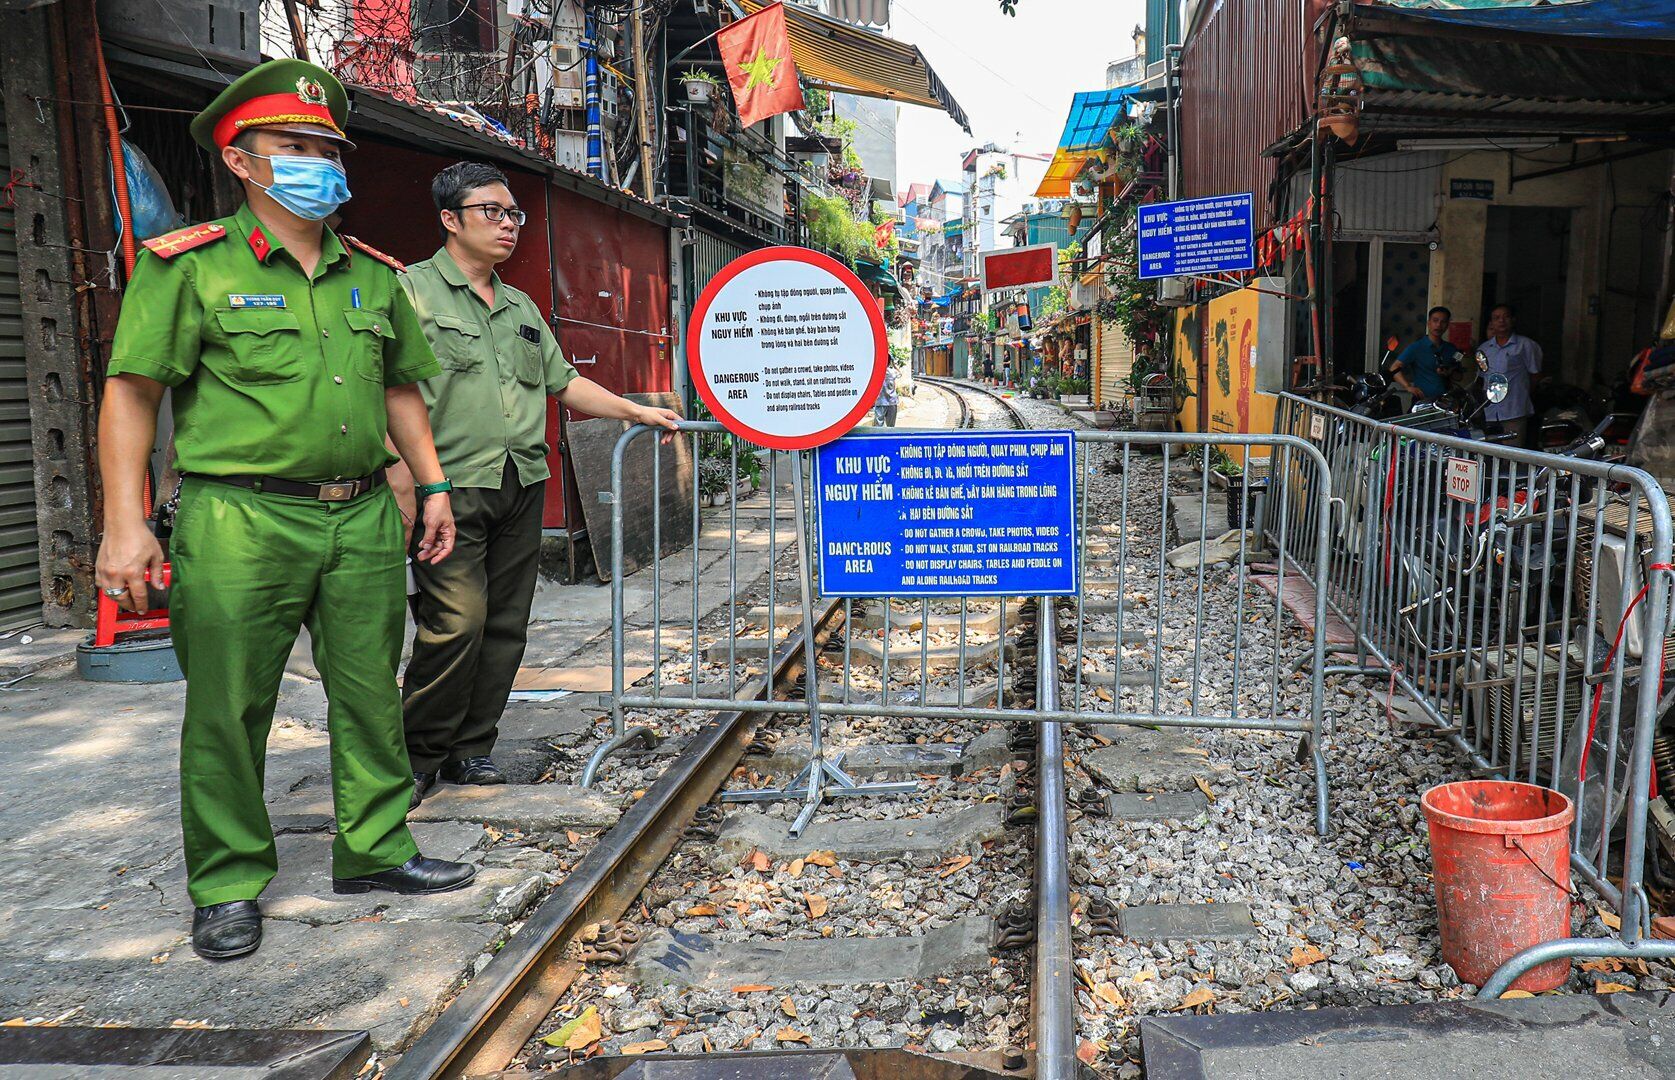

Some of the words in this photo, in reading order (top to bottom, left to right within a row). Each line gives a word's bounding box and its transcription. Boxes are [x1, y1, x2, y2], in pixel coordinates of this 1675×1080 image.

[1143, 214, 1155, 224] KHU
[1141, 228, 1156, 238] NGUY
[1142, 251, 1171, 261] DANGEROUS
[1149, 262, 1163, 270] AREA
[758, 290, 774, 298] Không
[820, 287, 832, 296] quay
[758, 302, 771, 312] chụp
[715, 312, 730, 322] KHU
[732, 311, 747, 324] VỰC
[760, 315, 775, 323] Không
[811, 312, 821, 321] trên
[838, 310, 846, 320] sắt
[712, 328, 731, 339] NGUY
[733, 324, 753, 339] HIỂM
[761, 327, 776, 336] Không
[761, 340, 774, 349] trong
[804, 338, 813, 347] bên
[830, 336, 838, 345] sắt
[764, 367, 771, 375] Do
[779, 366, 793, 375] gather
[798, 365, 812, 373] crowd,
[813, 364, 822, 373] take
[823, 364, 839, 372] photos,
[714, 372, 759, 384] DANGEROUS
[765, 379, 772, 387] Do
[780, 379, 792, 387] walk,
[793, 378, 806, 386] stand,
[820, 376, 837, 385] railroad
[837, 376, 851, 384] tracks
[728, 389, 748, 399] AREA
[781, 390, 796, 399] display
[827, 389, 836, 397] and
[836, 388, 851, 397] peddle
[766, 404, 775, 412] and
[776, 403, 788, 412] along
[789, 403, 806, 411] railroad
[806, 402, 820, 410] tracks
[900, 443, 923, 458] KHÔNG
[924, 446, 932, 460] TỤ
[933, 443, 946, 460] TẬP
[947, 443, 966, 457] ĐÔNG
[967, 441, 989, 458] NGƯỜI,
[991, 445, 1008, 458] QUAY
[1010, 444, 1029, 457] PHIM,
[1030, 443, 1048, 459] CHỤP
[1050, 439, 1064, 456] ẢNH
[836, 457, 862, 474] KHU
[865, 455, 891, 477] VỰC
[901, 464, 923, 479] KHÔNG
[935, 466, 955, 479] ĐG,
[956, 463, 972, 478] NGỒI
[974, 463, 990, 478] TRÊN
[992, 462, 1014, 477] ĐƯỜNG
[1016, 461, 1029, 477] SẮT
[1456, 463, 1469, 473] POLICE
[825, 484, 858, 501] NGUY
[862, 477, 893, 501] HIỂM
[1452, 476, 1470, 492] STOP
[902, 485, 924, 499] KHÔNG
[935, 484, 949, 499] BÀN
[951, 483, 965, 500] GHẾ,
[982, 484, 995, 498] BÁN
[997, 483, 1014, 498] HÀNG
[1016, 486, 1038, 498] TRONG
[1040, 483, 1057, 497] LÒNG
[910, 508, 921, 520] HAI
[922, 505, 936, 520] BÊN
[937, 505, 959, 520] ĐƯỜNG
[961, 503, 974, 519] SẮT
[904, 529, 914, 538] DO
[915, 528, 928, 538] NOT
[929, 528, 954, 538] GATHER
[955, 528, 960, 538] A
[989, 527, 1006, 537] TAKE
[1007, 527, 1034, 537] PHOTOS,
[1036, 527, 1059, 537] VIDEOS
[905, 545, 914, 554] DO
[915, 544, 928, 554] NOT
[952, 544, 975, 554] STAND,
[988, 543, 998, 553] ON
[1000, 543, 1031, 553] RAILROAD
[1033, 543, 1058, 552] TRACKS
[845, 559, 874, 573] AREA
[905, 560, 914, 569] DO
[916, 560, 928, 569] NOT
[930, 560, 957, 569] DISPLAY
[958, 559, 984, 570] CHAIRS,
[986, 559, 1010, 568] TABLES
[1011, 559, 1025, 568] AND
[1026, 558, 1051, 568] PEDDLE
[1053, 558, 1062, 567] ON
[901, 576, 915, 585] AND
[916, 576, 938, 585] ALONG
[939, 575, 971, 585] RAILROAD
[972, 575, 998, 585] TRACKS
